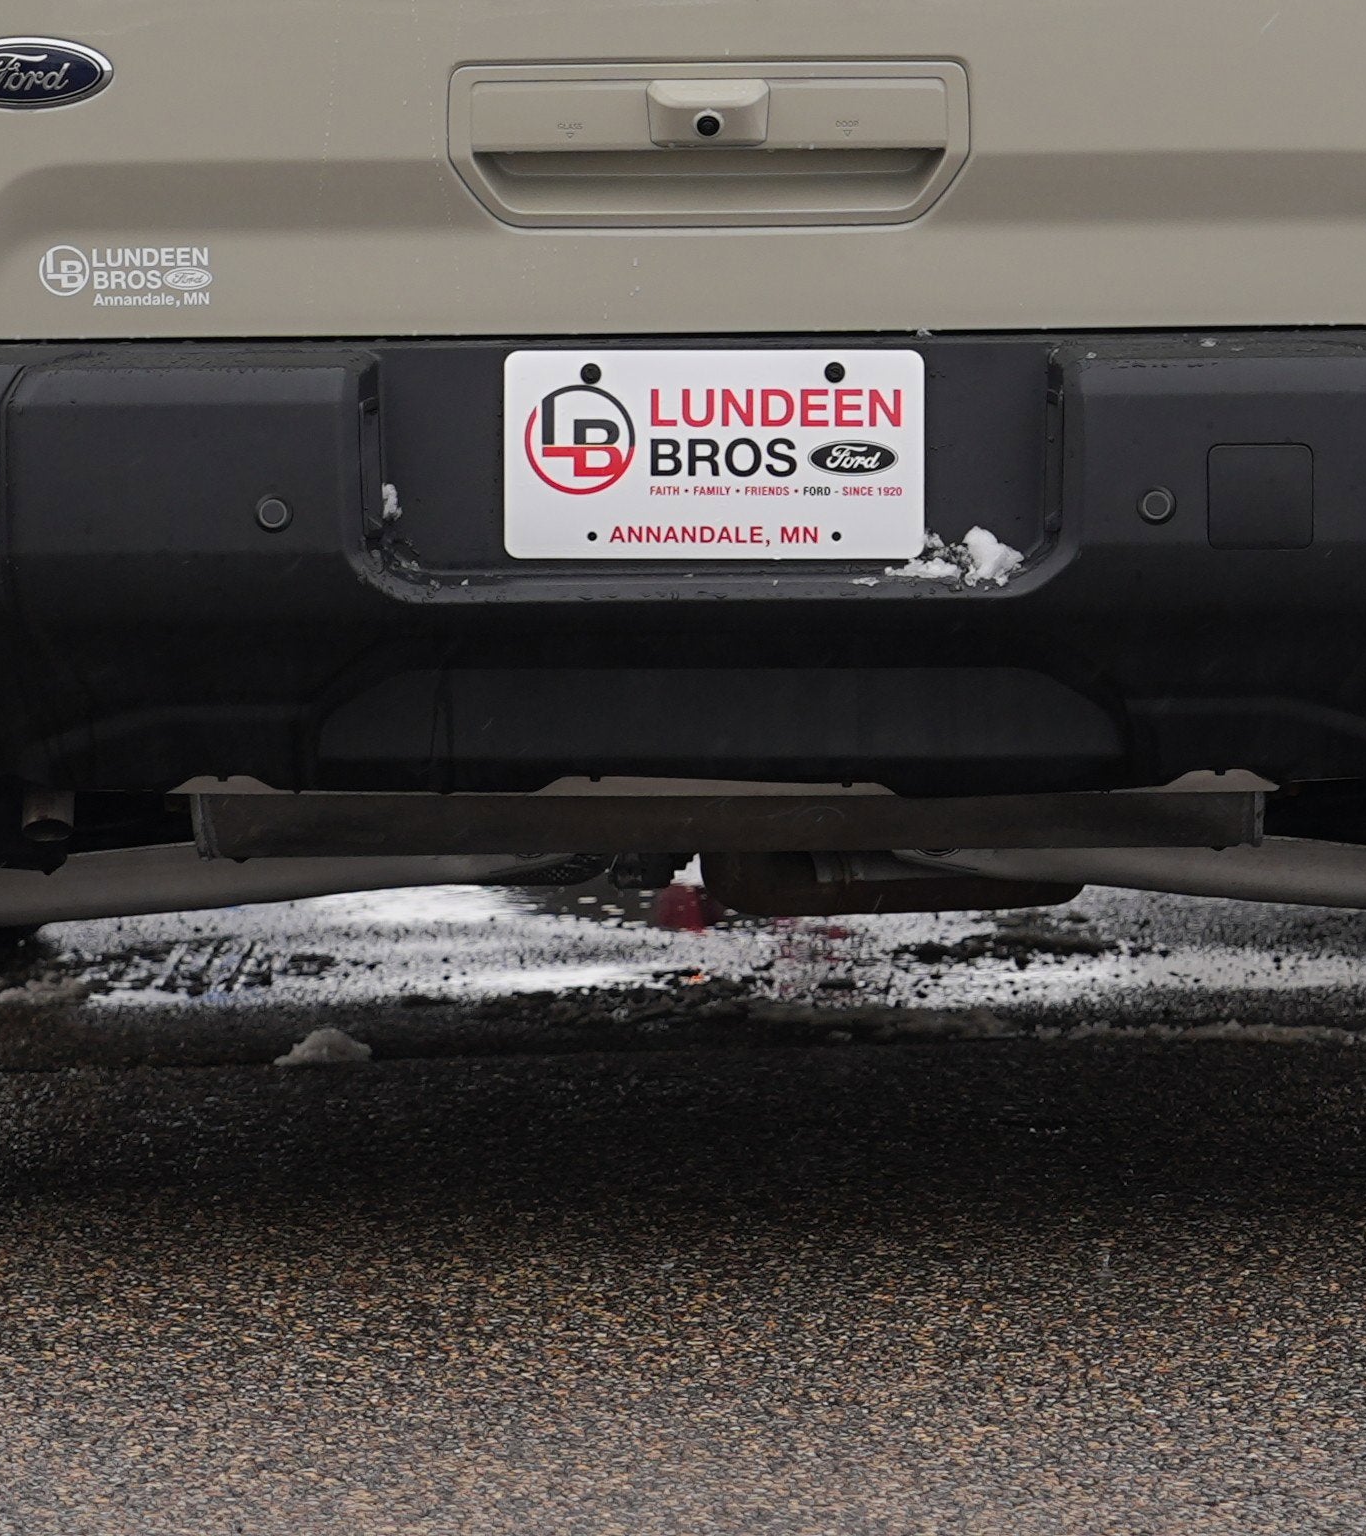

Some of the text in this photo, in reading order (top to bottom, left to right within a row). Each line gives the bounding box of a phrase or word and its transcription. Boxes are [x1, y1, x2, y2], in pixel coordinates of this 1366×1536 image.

[91, 246, 210, 268] LUNDEEN
[93, 270, 162, 290] BROS
[93, 292, 210, 308] Annandale, MN
[649, 388, 902, 427] LUNDEEN
[649, 438, 881, 477] BROS Ford
[649, 486, 903, 496] FAITH FAMILY FRIENDS FORD SINCE 1920
[609, 525, 819, 547] ANNANDALE, MN
